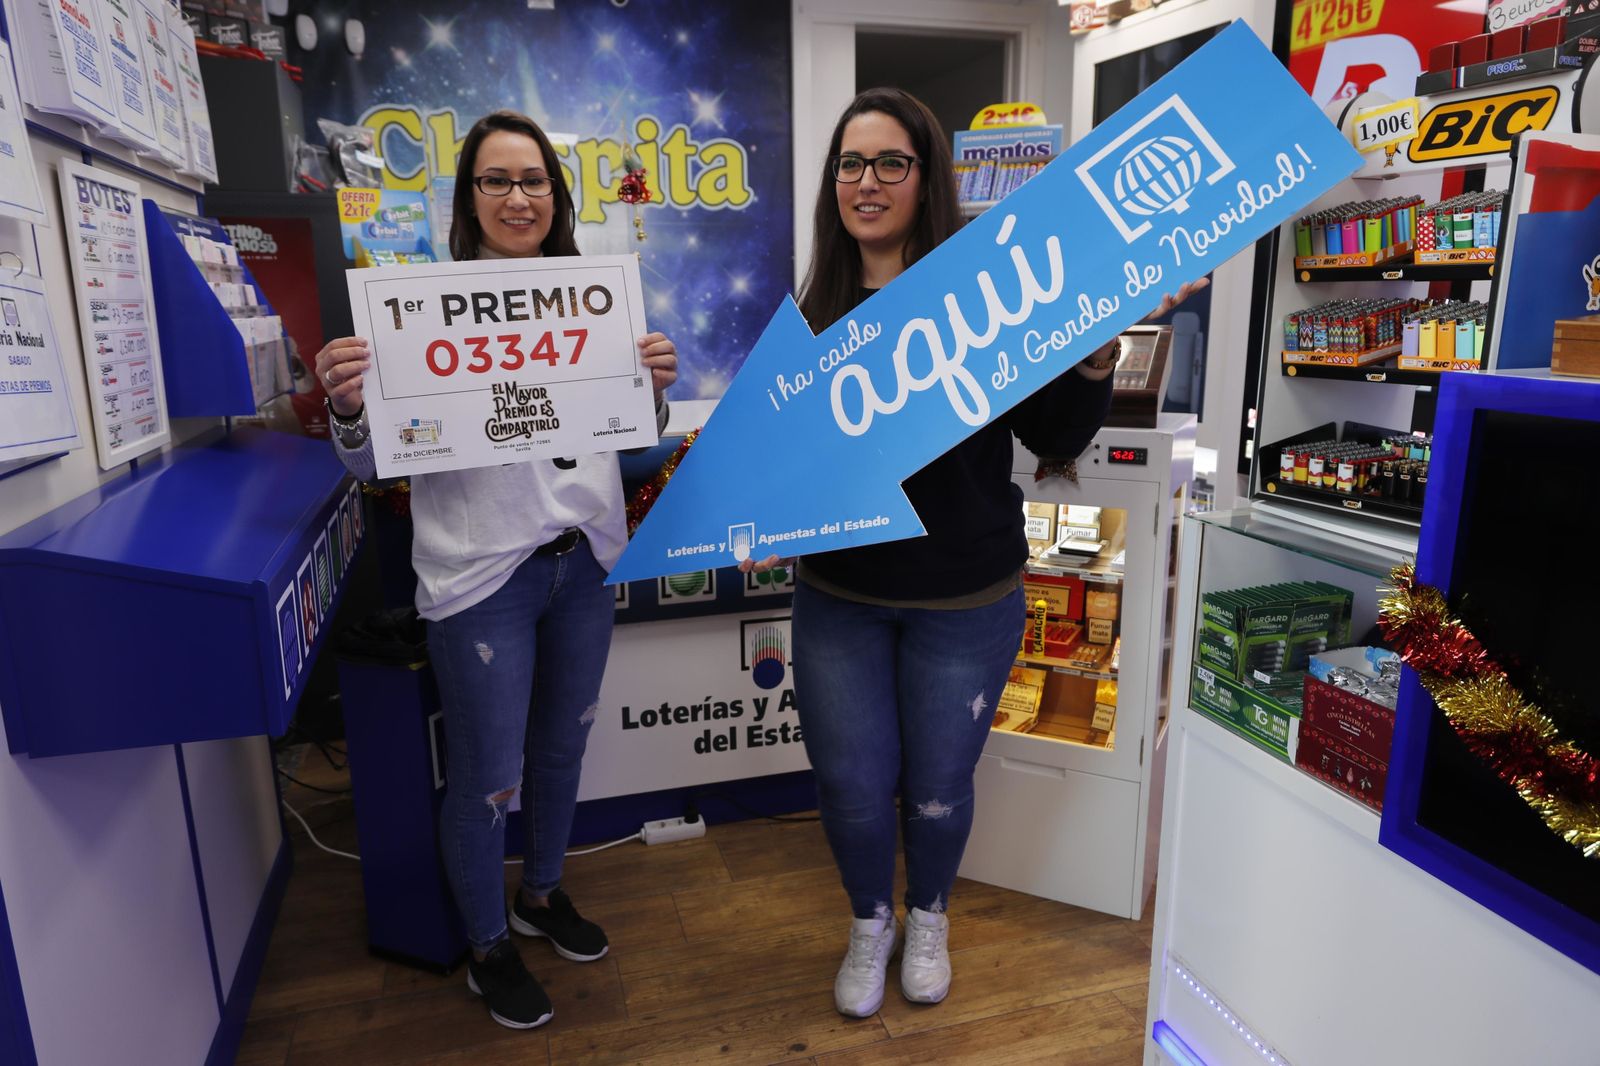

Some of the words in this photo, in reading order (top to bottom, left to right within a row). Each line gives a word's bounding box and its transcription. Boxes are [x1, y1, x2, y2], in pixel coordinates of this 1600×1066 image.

[1491, 6, 1507, 30] 3
[983, 106, 1035, 126] 2x1€
[1358, 111, 1412, 142] 1,00€
[361, 104, 753, 225] Chspita
[962, 141, 1052, 161] mentos
[76, 179, 131, 214] BOTES
[342, 191, 375, 203] OFERTA
[991, 351, 1019, 391] el
[1023, 293, 1120, 363] Gordo
[1124, 260, 1163, 298] de
[1158, 143, 1317, 266] Navidad!
[441, 284, 613, 326] PREMIO
[830, 213, 1064, 437] aquí
[15, 330, 45, 348] Nacional
[426, 329, 588, 377] 03347
[492, 383, 505, 395] EL
[504, 381, 547, 406] MAYOR
[493, 396, 537, 422] PREMIO
[540, 400, 554, 417] ES
[485, 418, 560, 442] COMPARTIRLO
[614, 426, 637, 434] Nacional
[393, 452, 402, 460] 22
[413, 446, 453, 457] DICIEMBRE
[667, 543, 716, 558] Loterías
[718, 542, 726, 553] y
[758, 528, 816, 545] Apuestas
[820, 523, 840, 535] del
[844, 515, 890, 531] Estado
[1066, 528, 1092, 537] Fumar
[1033, 607, 1046, 653] CAMACHO
[622, 697, 743, 730] Loterías
[752, 698, 769, 721] y
[694, 726, 737, 754] del
